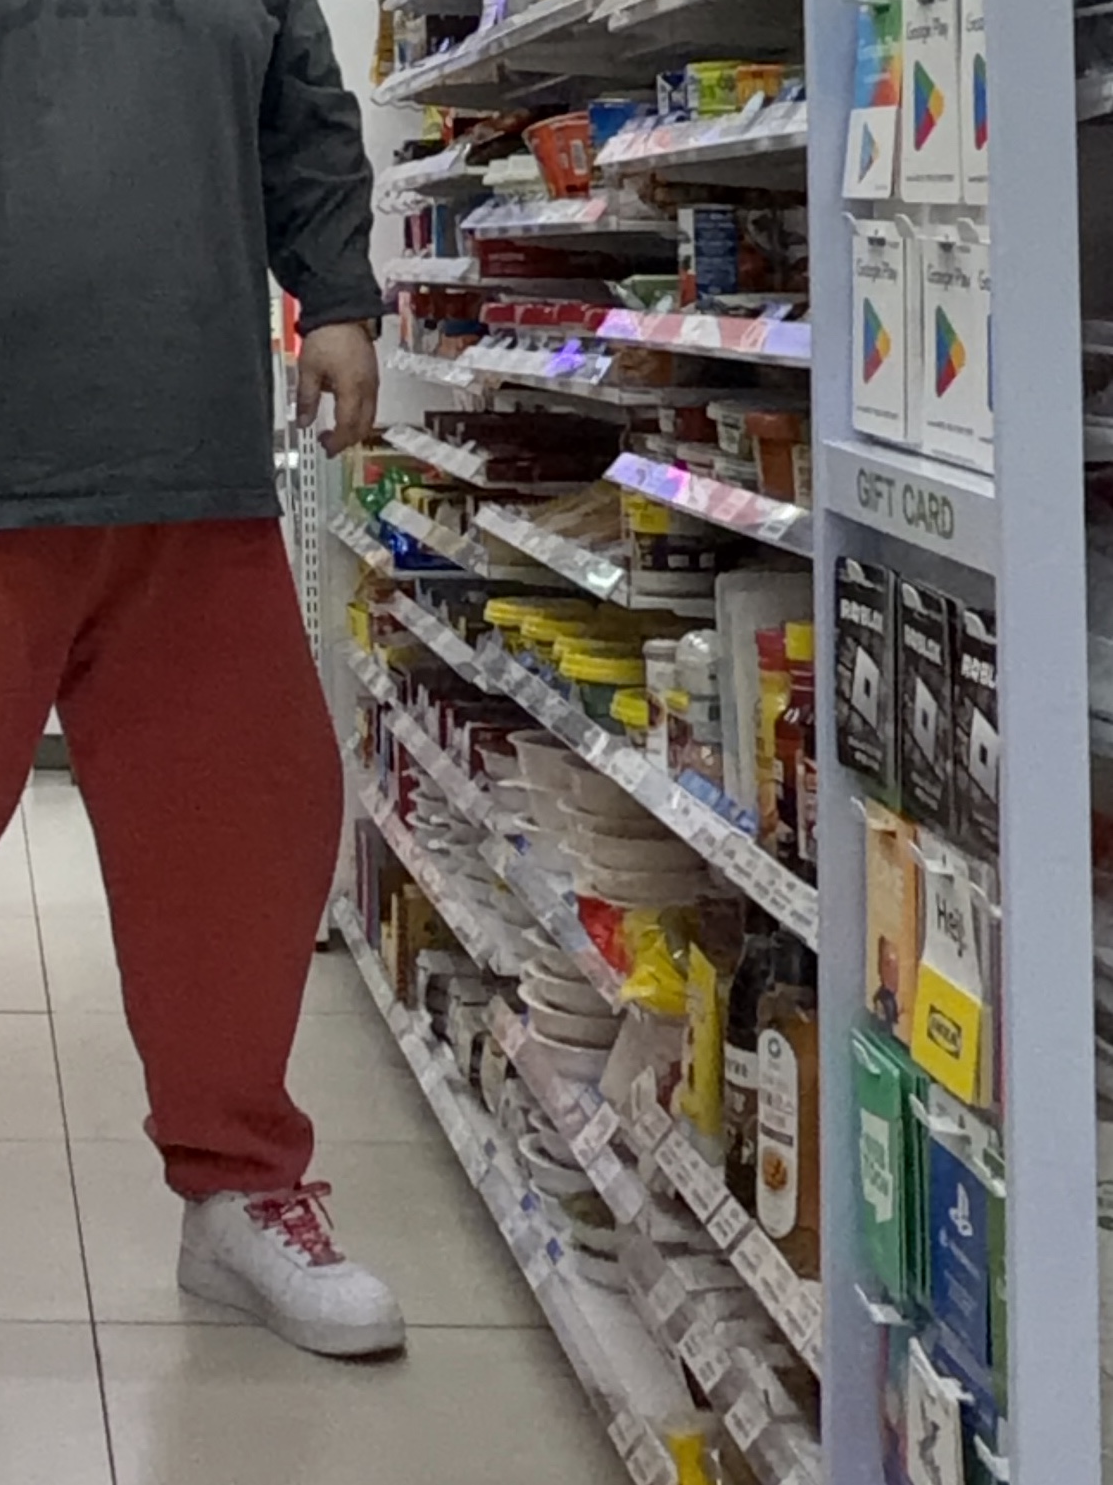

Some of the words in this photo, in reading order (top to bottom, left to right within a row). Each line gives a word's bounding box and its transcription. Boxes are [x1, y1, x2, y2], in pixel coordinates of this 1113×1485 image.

[856, 467, 896, 519] GIFT
[902, 482, 954, 540] CARD
[960, 652, 998, 690] ROBL
